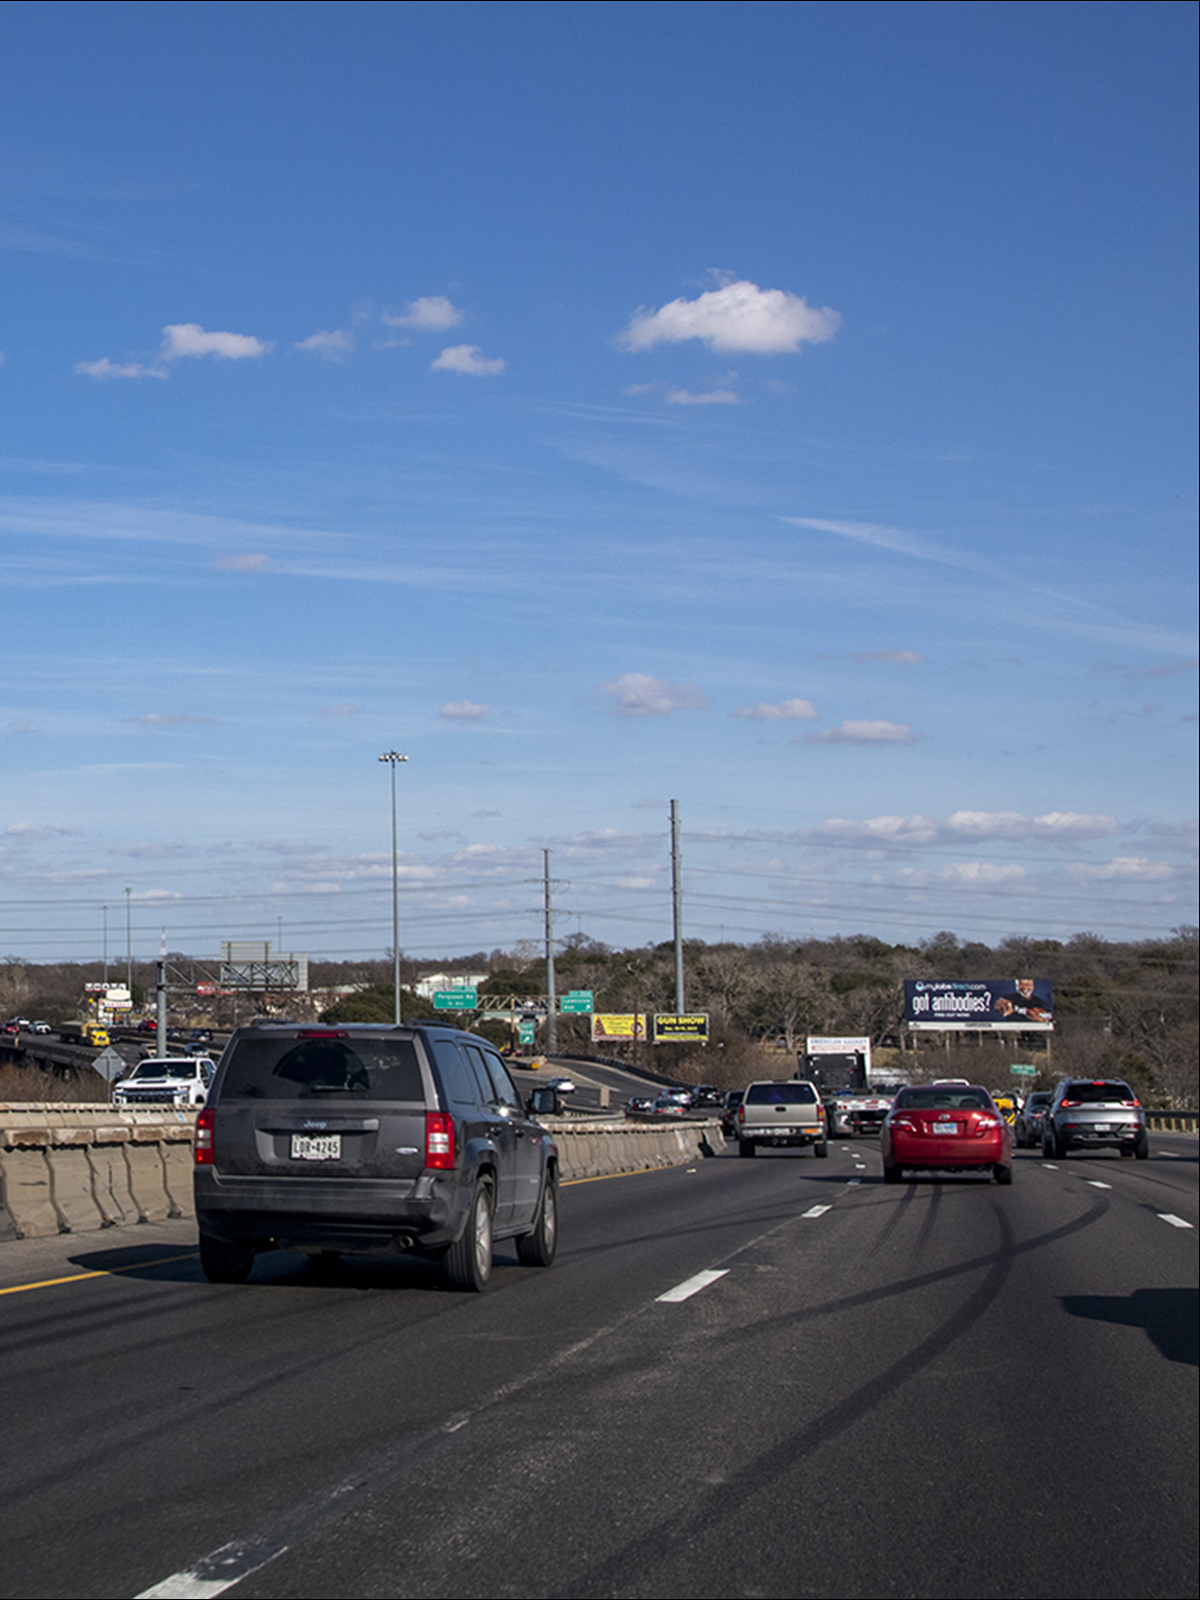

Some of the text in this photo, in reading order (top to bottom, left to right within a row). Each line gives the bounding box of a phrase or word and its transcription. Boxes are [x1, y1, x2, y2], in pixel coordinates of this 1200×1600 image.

[912, 991, 992, 1015] got antibodies?
[657, 1016, 705, 1024] GUN SHOW
[303, 1119, 327, 1130] Jeep
